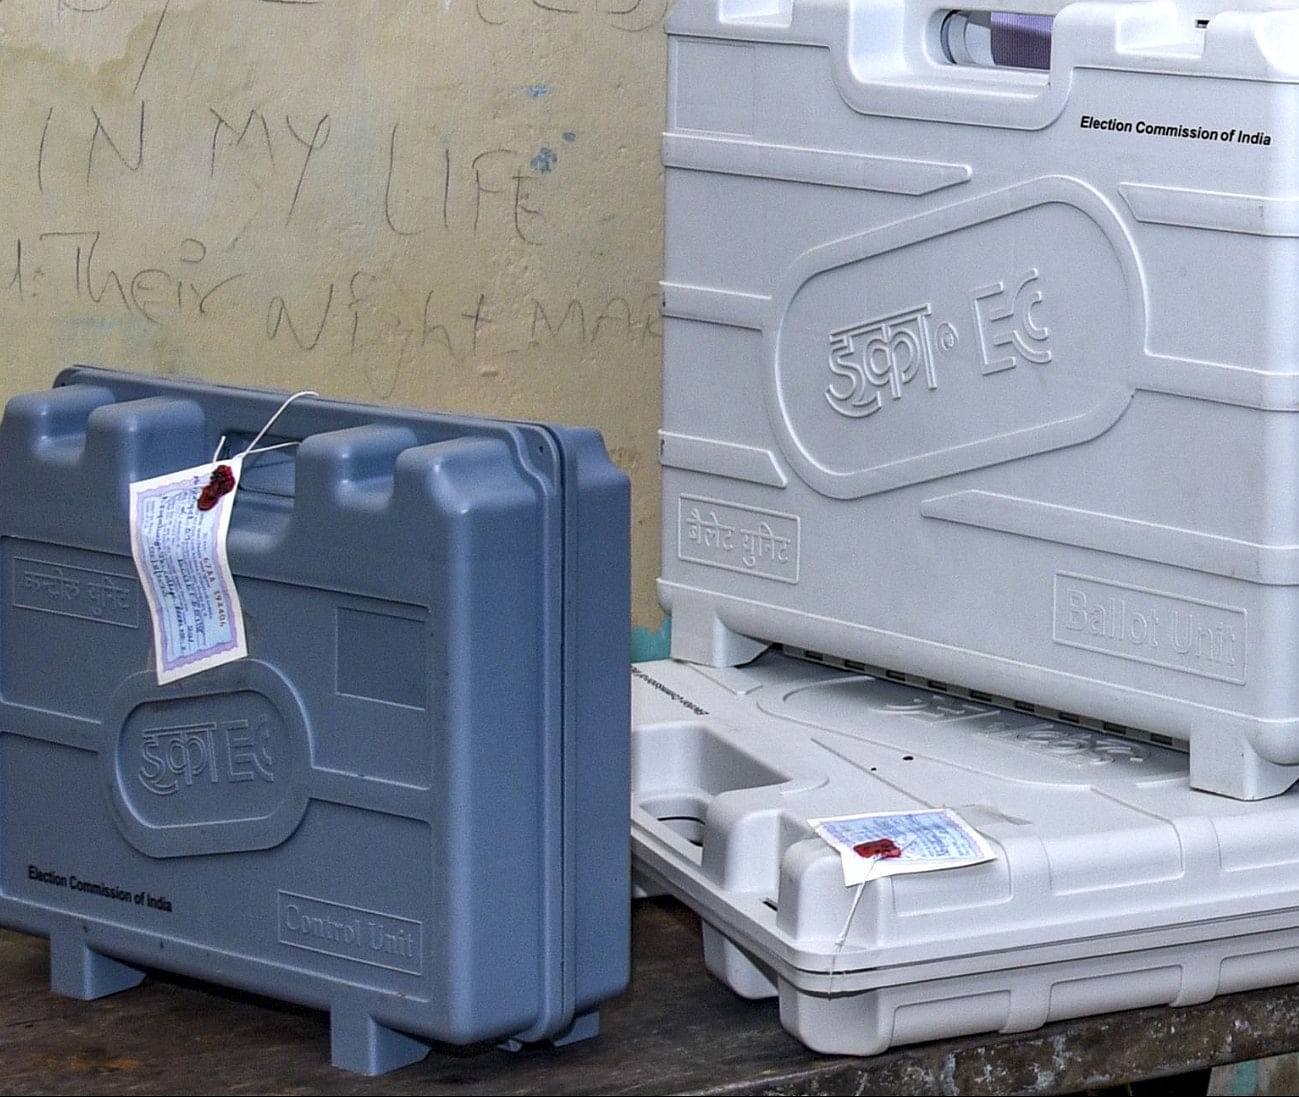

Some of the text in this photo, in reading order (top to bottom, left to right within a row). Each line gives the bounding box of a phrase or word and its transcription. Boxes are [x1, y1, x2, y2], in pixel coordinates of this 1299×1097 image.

[1080, 115, 1272, 146] Election Commission of India
[36, 100, 547, 244] IN MY LIFE
[1066, 589, 1235, 666] Ballot Unit
[28, 865, 172, 912] Election Commission of India
[287, 905, 413, 958] Control Unit
